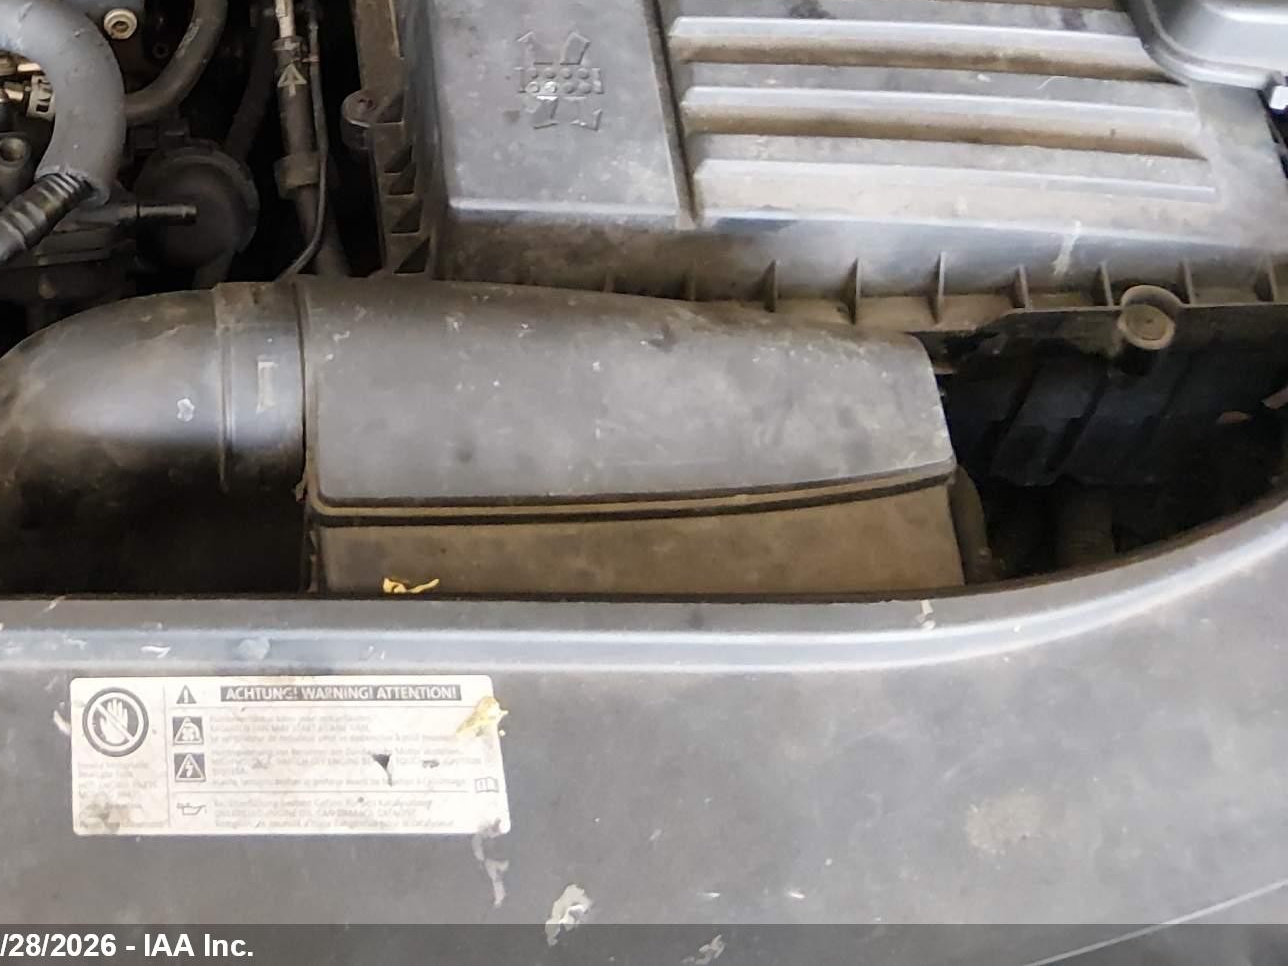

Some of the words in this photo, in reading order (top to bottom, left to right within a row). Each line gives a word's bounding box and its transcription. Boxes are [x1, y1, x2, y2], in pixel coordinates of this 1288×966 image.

[225, 686, 299, 701] ACHTUNG!
[301, 686, 373, 700] WARNING!
[376, 685, 457, 700] ATTENTION!
